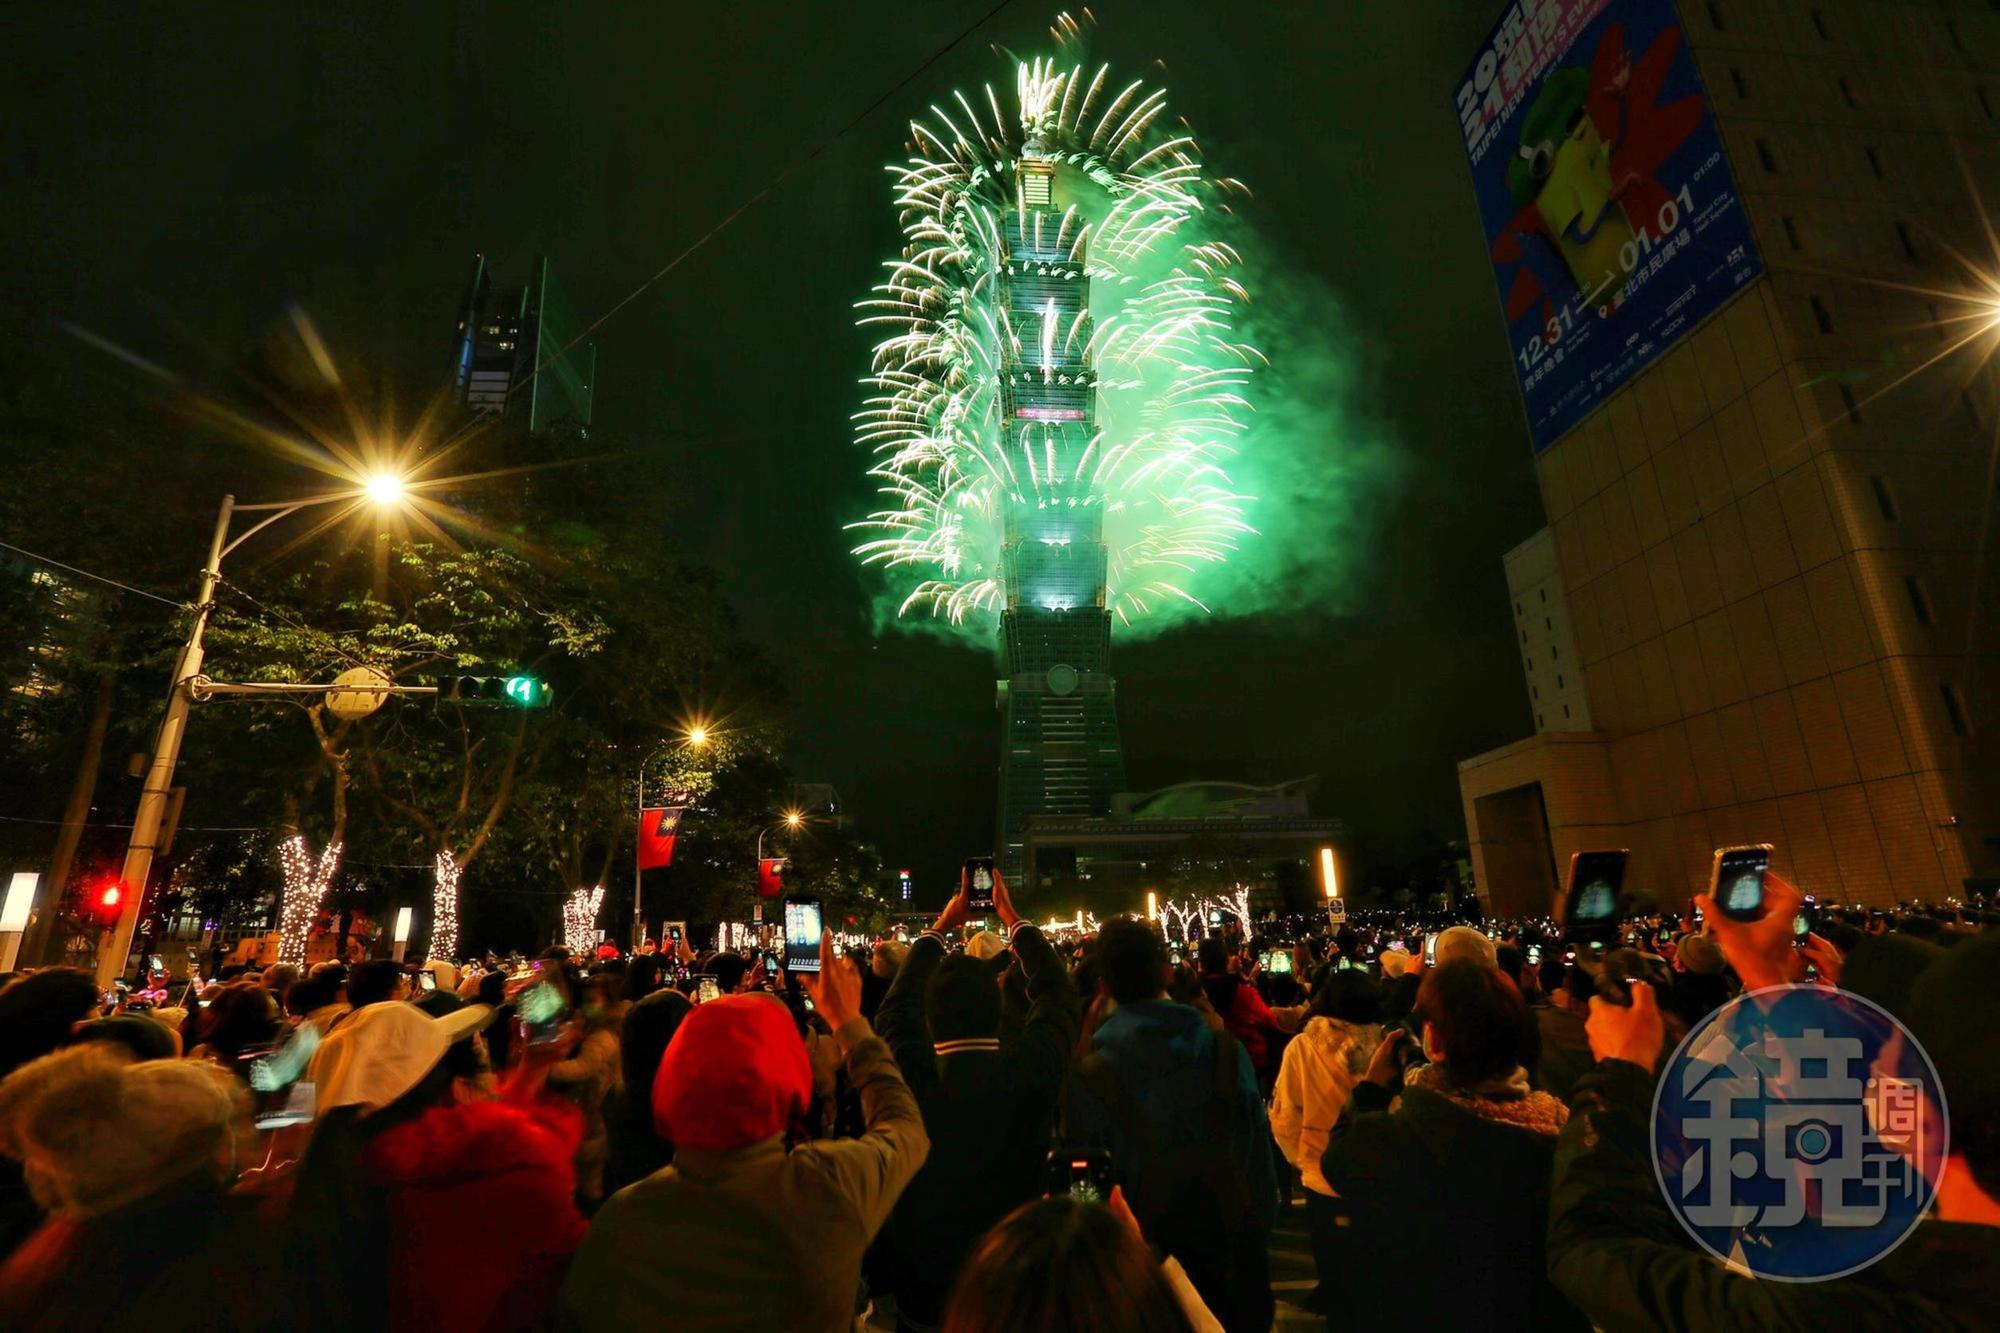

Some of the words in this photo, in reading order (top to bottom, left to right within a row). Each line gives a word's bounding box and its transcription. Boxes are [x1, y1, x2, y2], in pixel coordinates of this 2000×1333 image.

[1471, 118, 1501, 166] TAIPEI
[1502, 83, 1526, 124] NEW
[1693, 152, 1720, 181] 01:00
[1619, 183, 1694, 272] 01.01
[1518, 304, 1573, 371] 12.31
